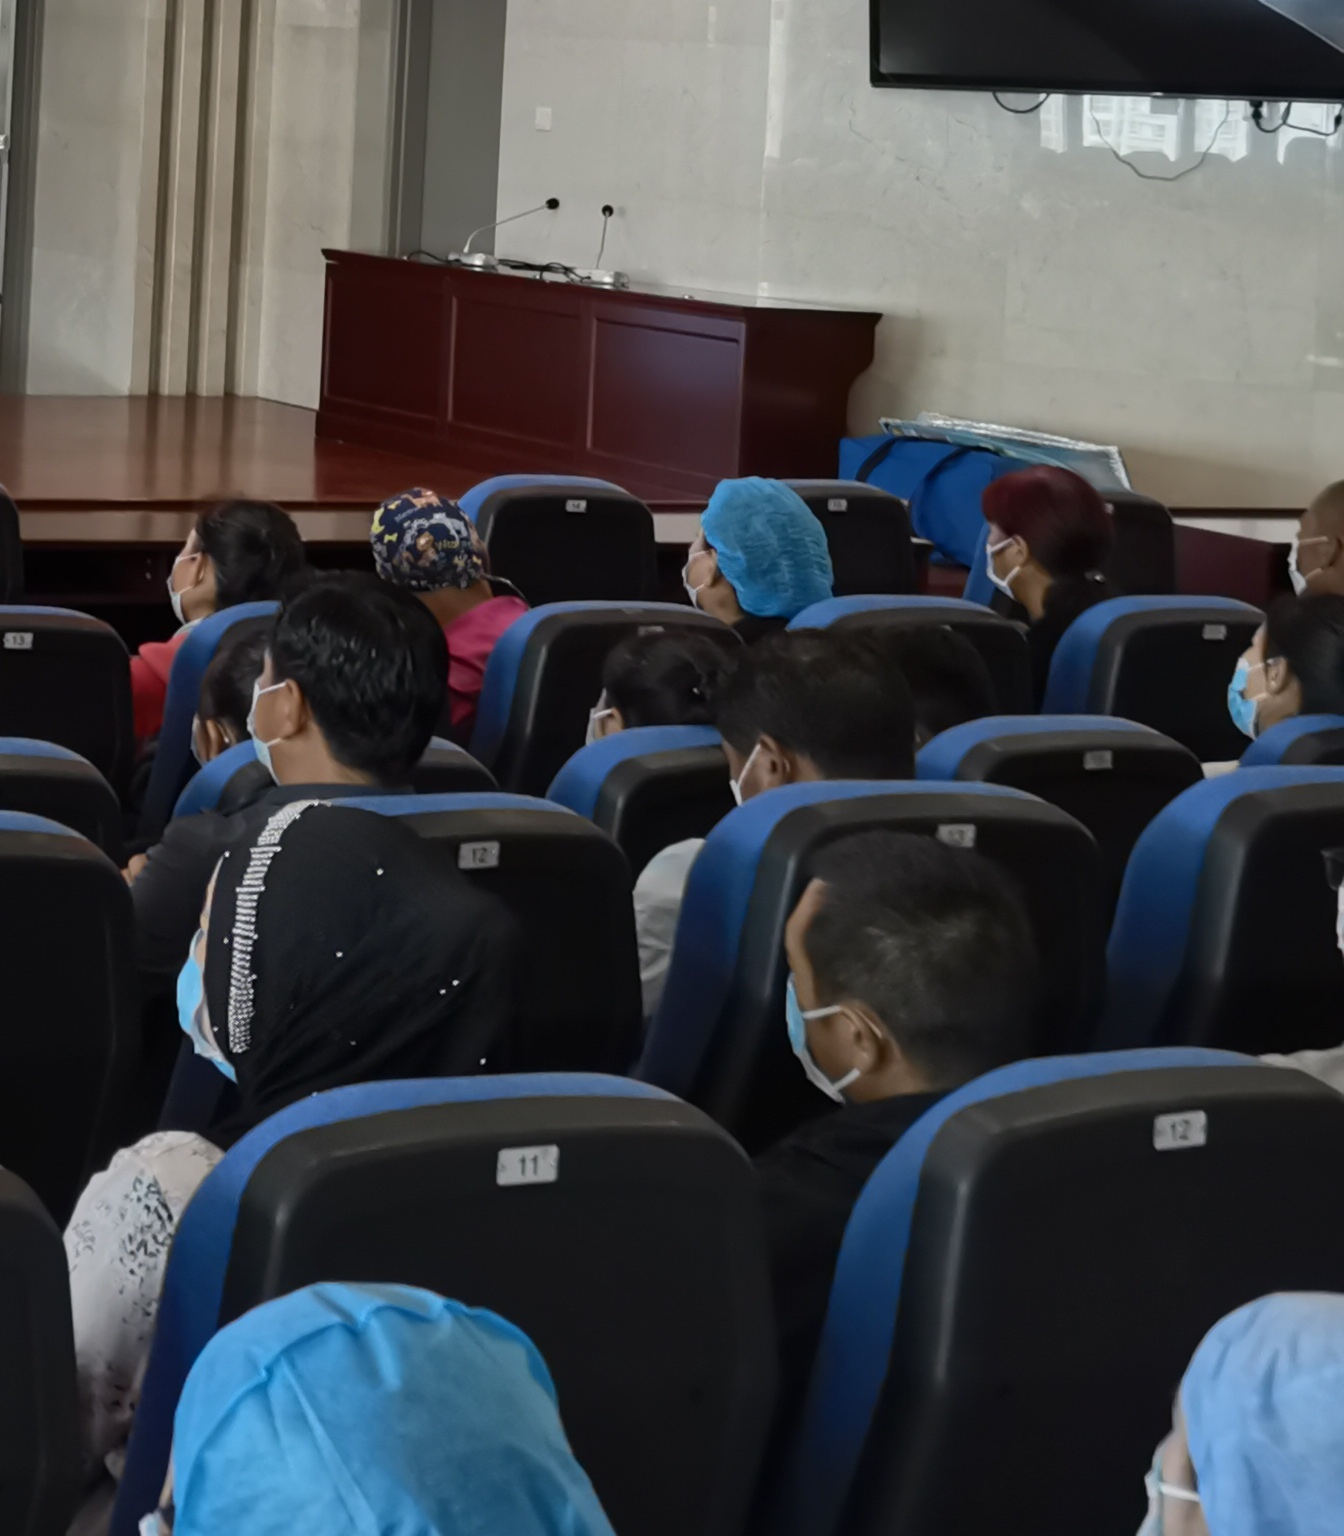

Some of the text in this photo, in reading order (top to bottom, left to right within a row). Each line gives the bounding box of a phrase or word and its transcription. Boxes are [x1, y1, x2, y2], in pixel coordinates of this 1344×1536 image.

[11, 635, 25, 646] 13
[1169, 1119, 1191, 1142] 12
[517, 1154, 540, 1177] 11
